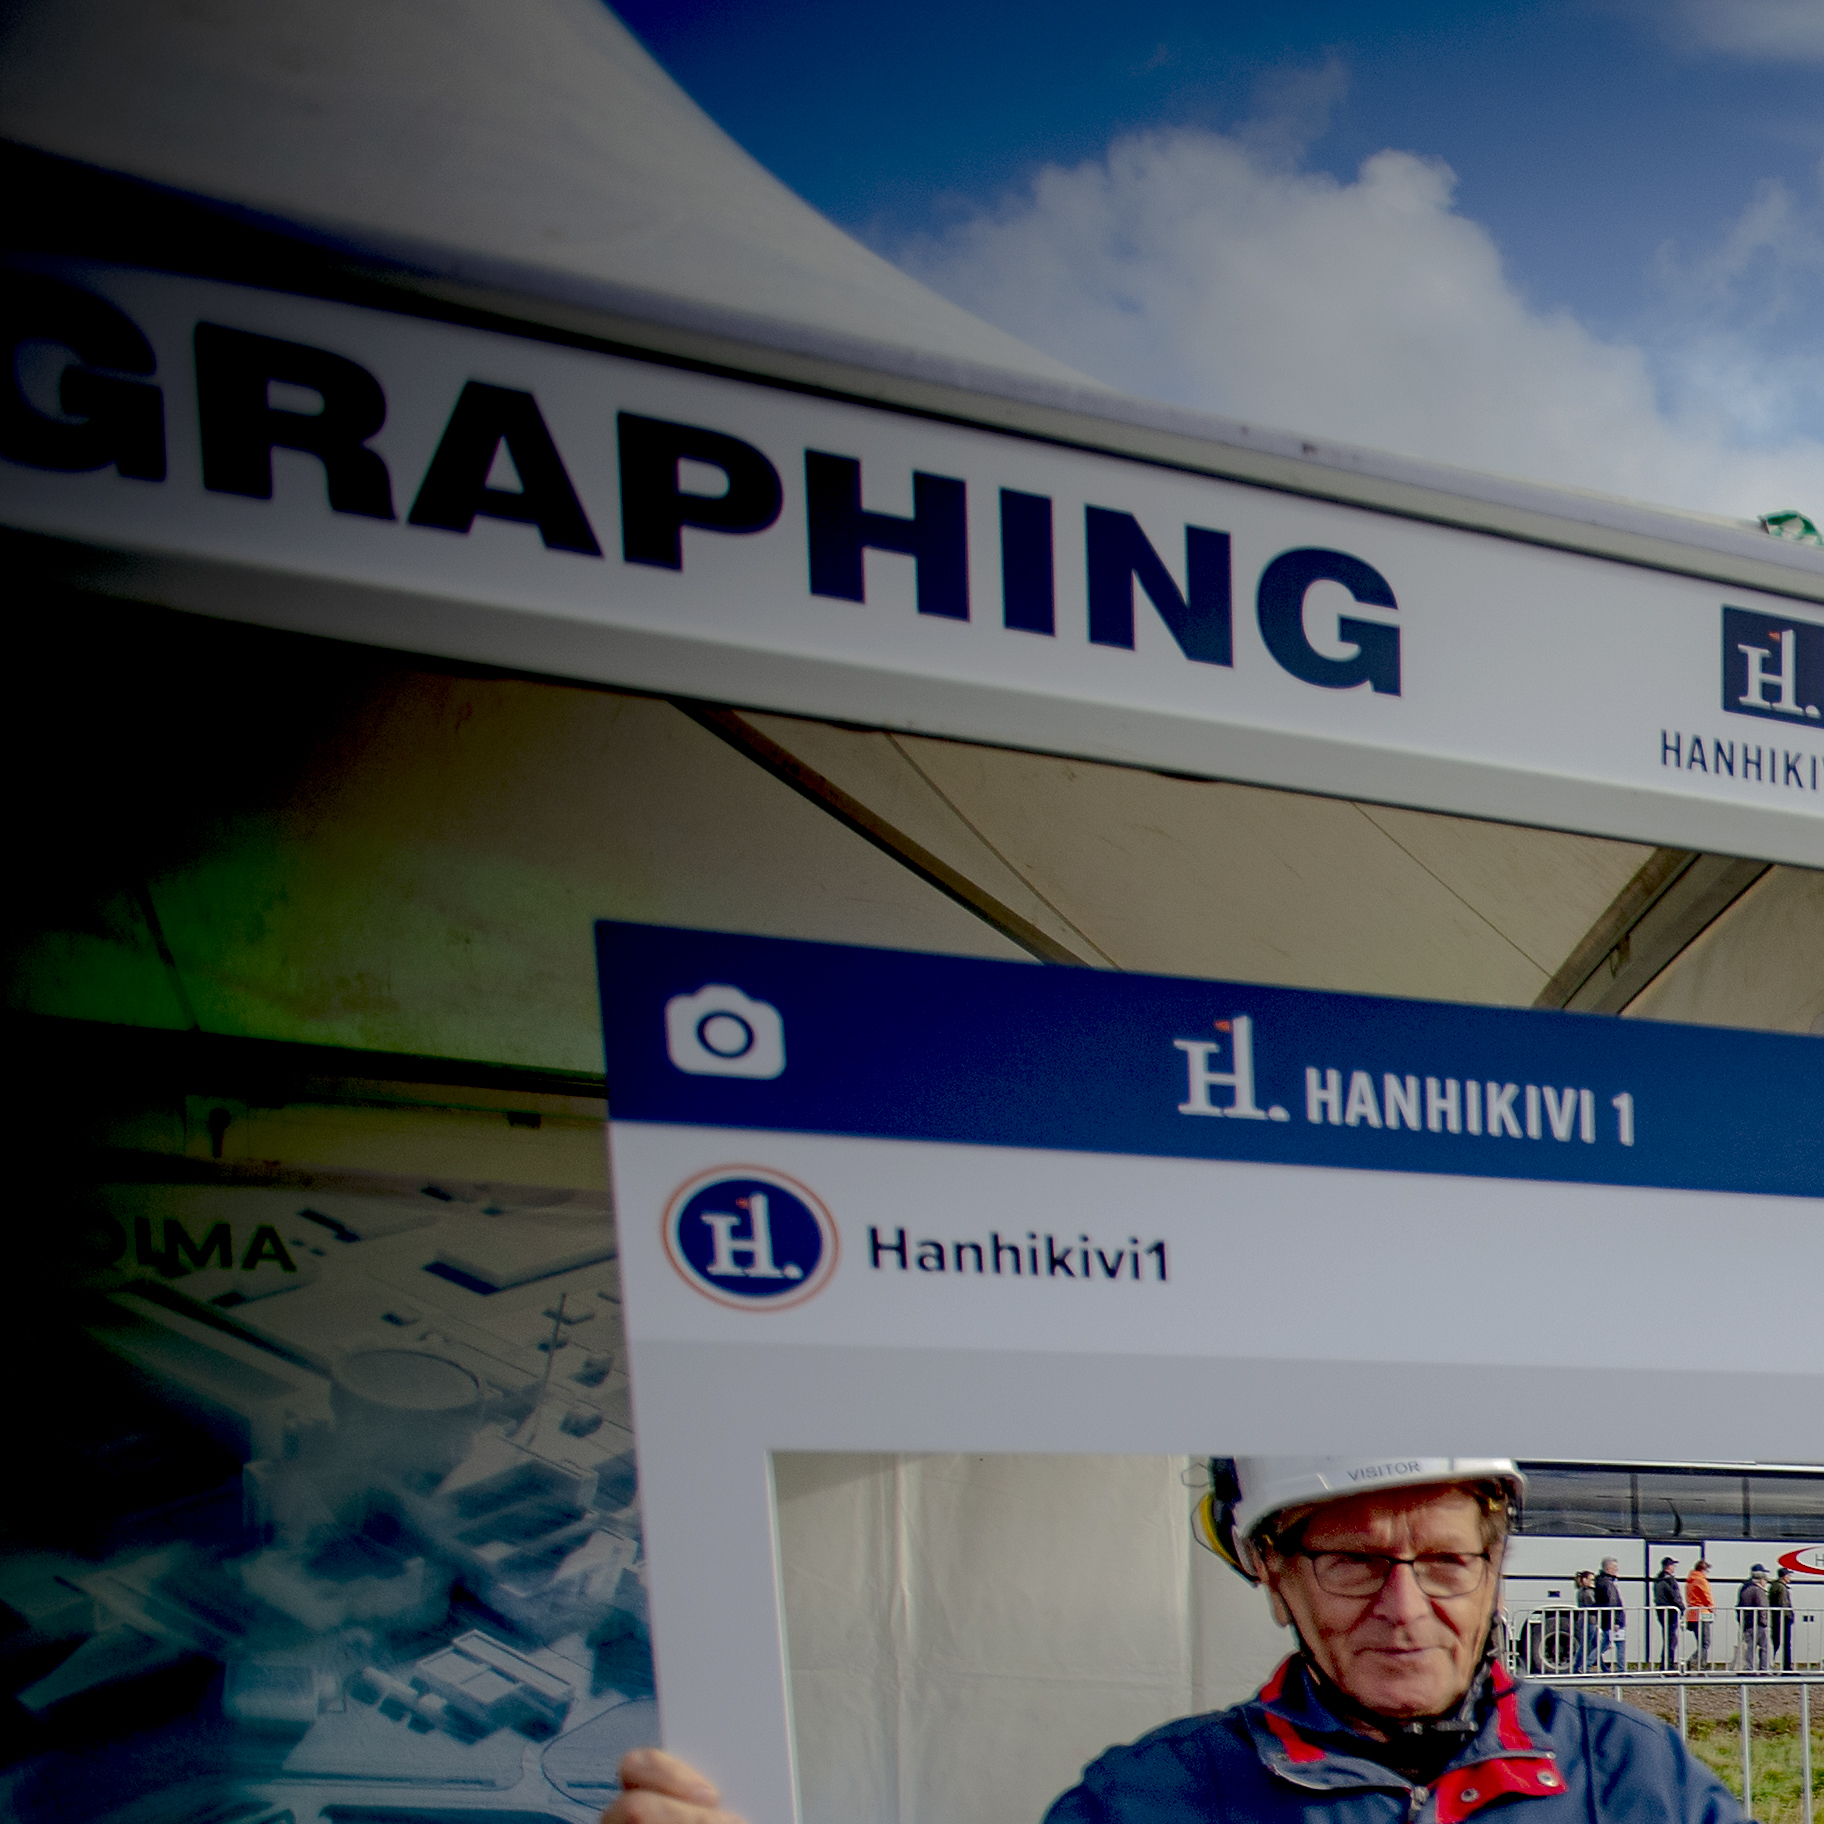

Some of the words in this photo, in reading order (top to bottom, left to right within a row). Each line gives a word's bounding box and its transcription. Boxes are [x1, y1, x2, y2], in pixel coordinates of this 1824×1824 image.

[0, 272, 1404, 697] GRAPHING
[1305, 1066, 1596, 1144] HANHIKIVI
[1612, 1091, 1635, 1146] 1
[867, 1226, 1169, 1282] Hanhikivi1
[1347, 1460, 1421, 1481] VISITOR
